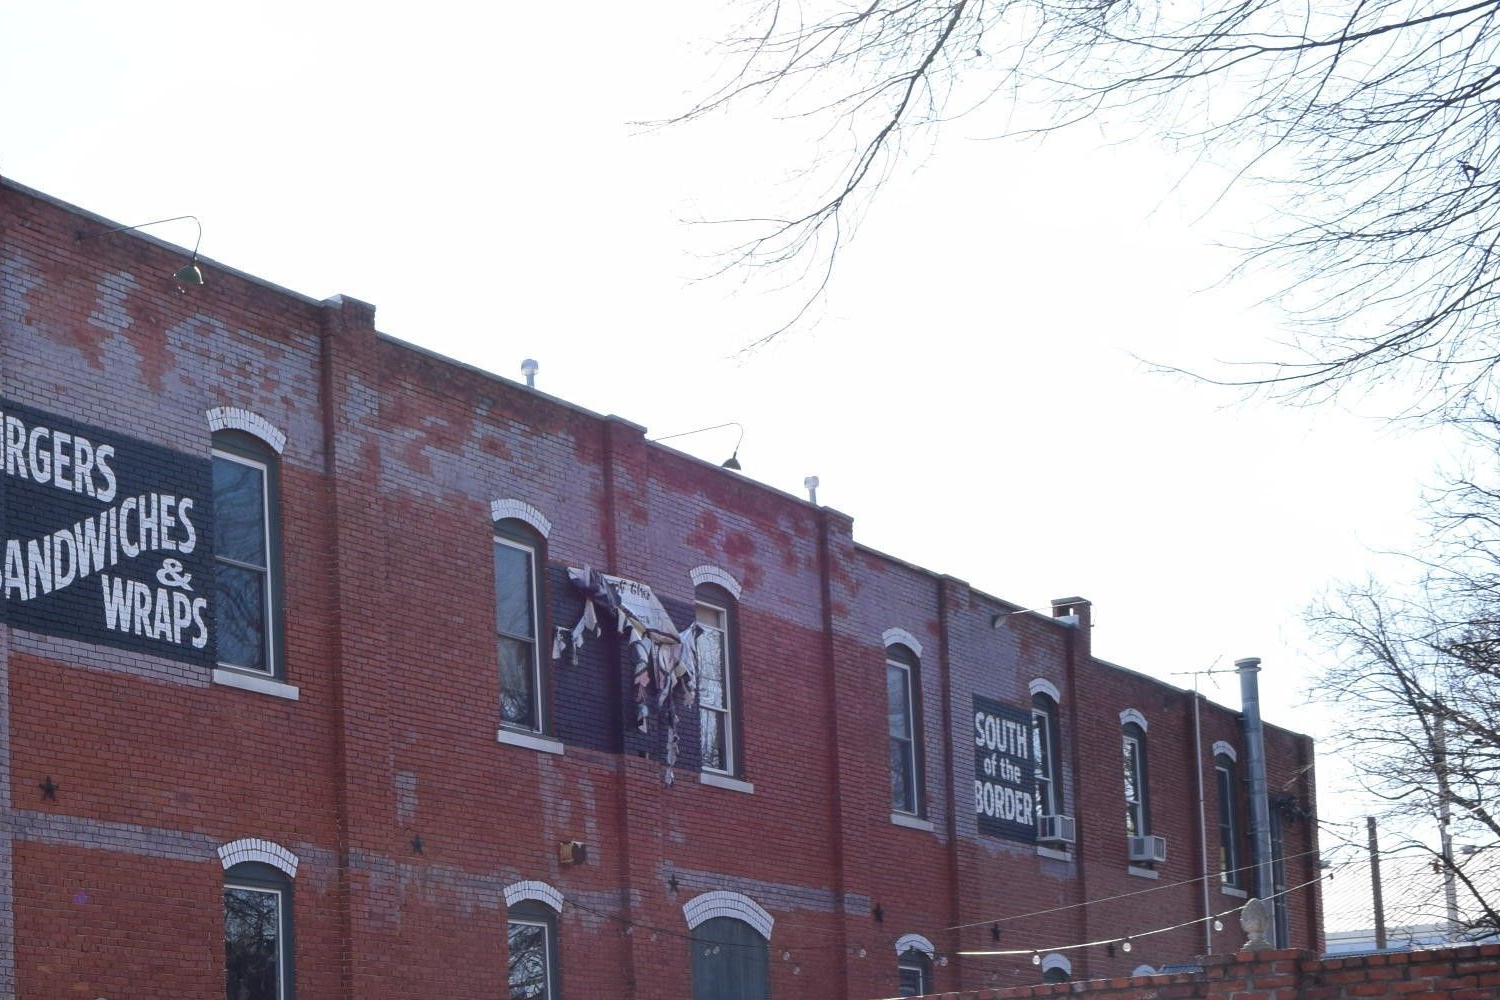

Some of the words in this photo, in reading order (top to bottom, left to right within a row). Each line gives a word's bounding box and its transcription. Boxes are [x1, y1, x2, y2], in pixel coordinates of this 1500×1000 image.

[156, 558, 193, 591] &
[101, 574, 208, 649] WRAPS
[974, 712, 1028, 759] SOUTH
[984, 753, 997, 776] of
[1000, 758, 1021, 784] the
[974, 780, 1033, 826] BORDER
